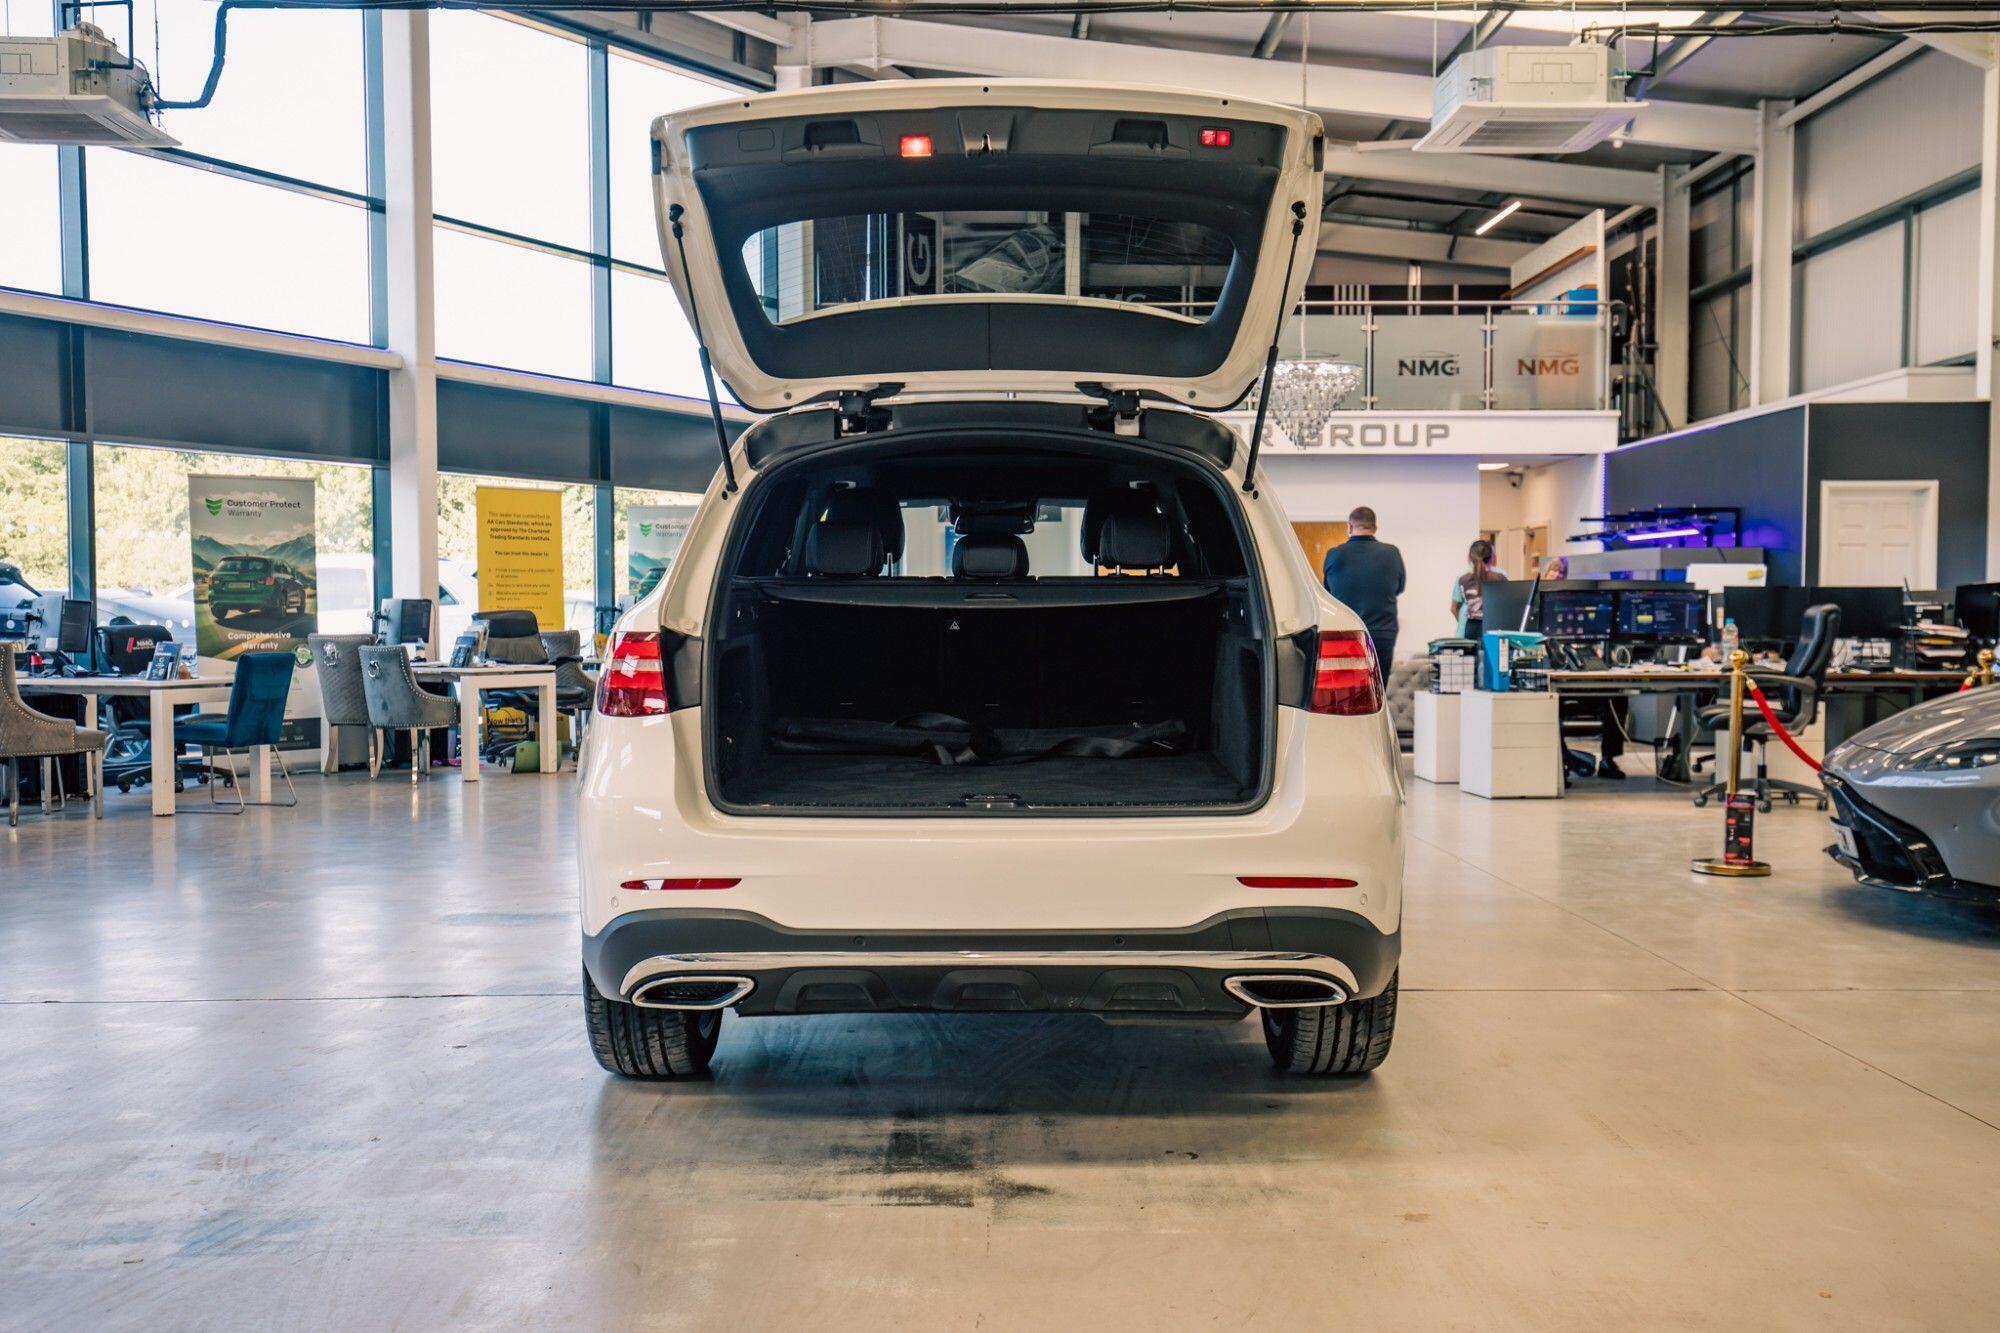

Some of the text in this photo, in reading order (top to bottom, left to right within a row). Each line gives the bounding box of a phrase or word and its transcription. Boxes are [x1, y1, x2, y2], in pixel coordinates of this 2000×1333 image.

[1398, 359, 1460, 376] NMG
[1517, 358, 1580, 376] NMG
[226, 499, 301, 509] Customer Protect
[227, 509, 262, 518] Warranty
[227, 631, 291, 640] Comprehensive
[241, 641, 279, 650] Warranty
